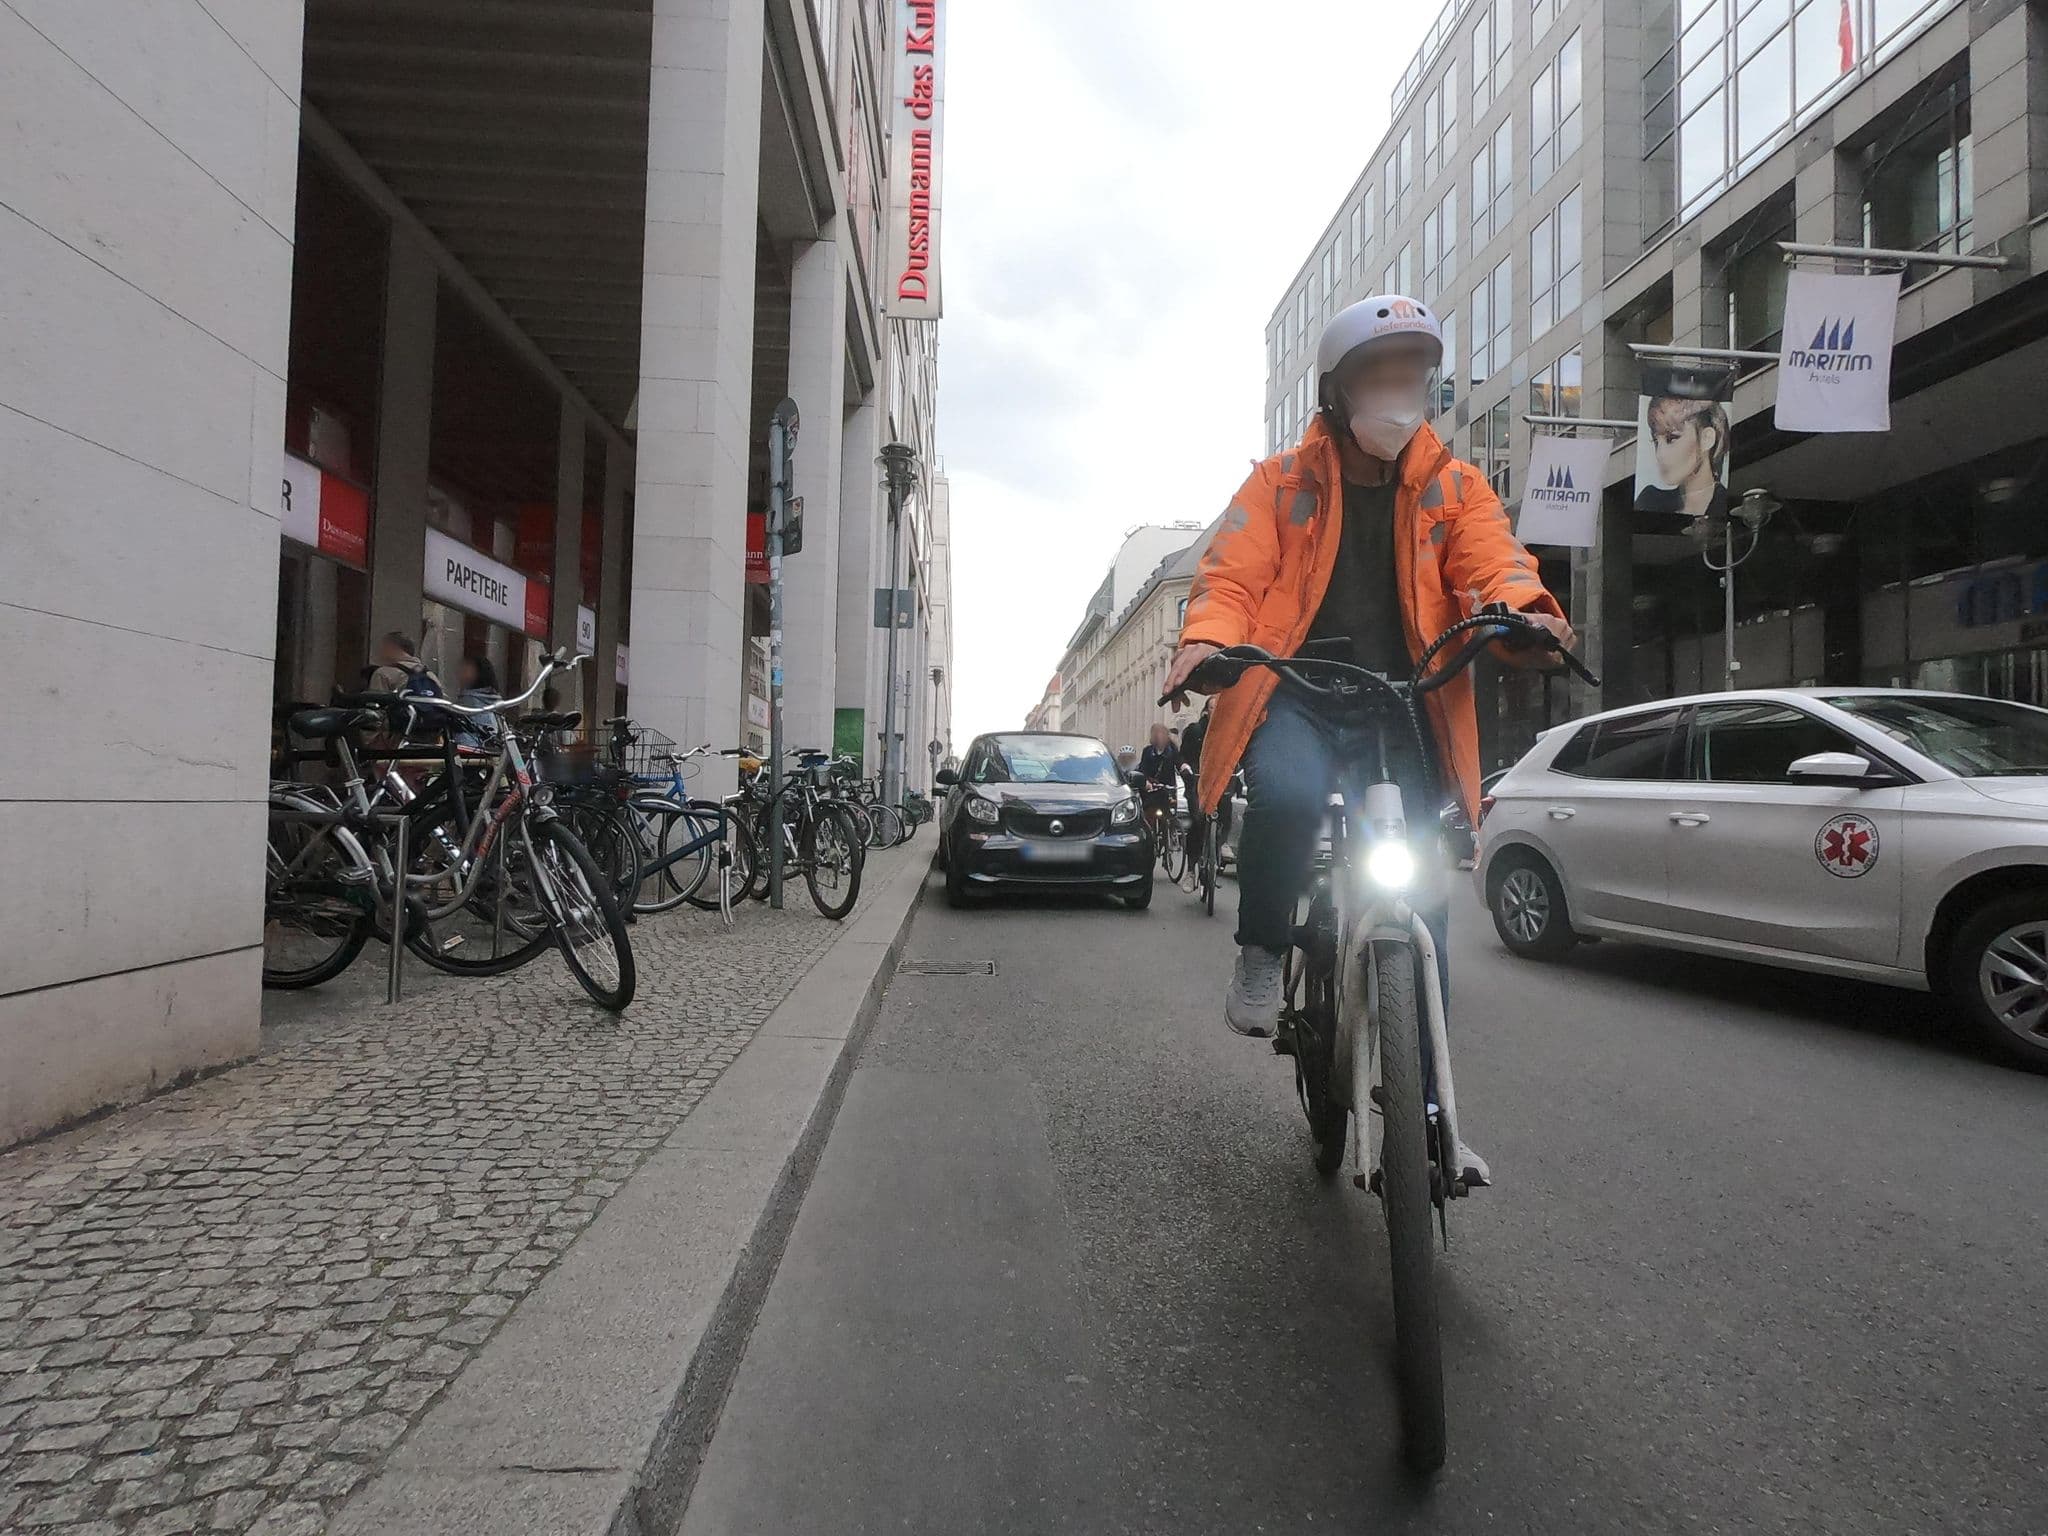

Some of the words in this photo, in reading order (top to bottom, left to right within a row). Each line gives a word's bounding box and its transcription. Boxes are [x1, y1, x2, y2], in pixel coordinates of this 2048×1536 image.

[904, 63, 934, 121] das
[898, 127, 933, 303] Dussmann
[1788, 350, 1872, 372] MARITIM
[446, 558, 508, 607] PAPETERIE
